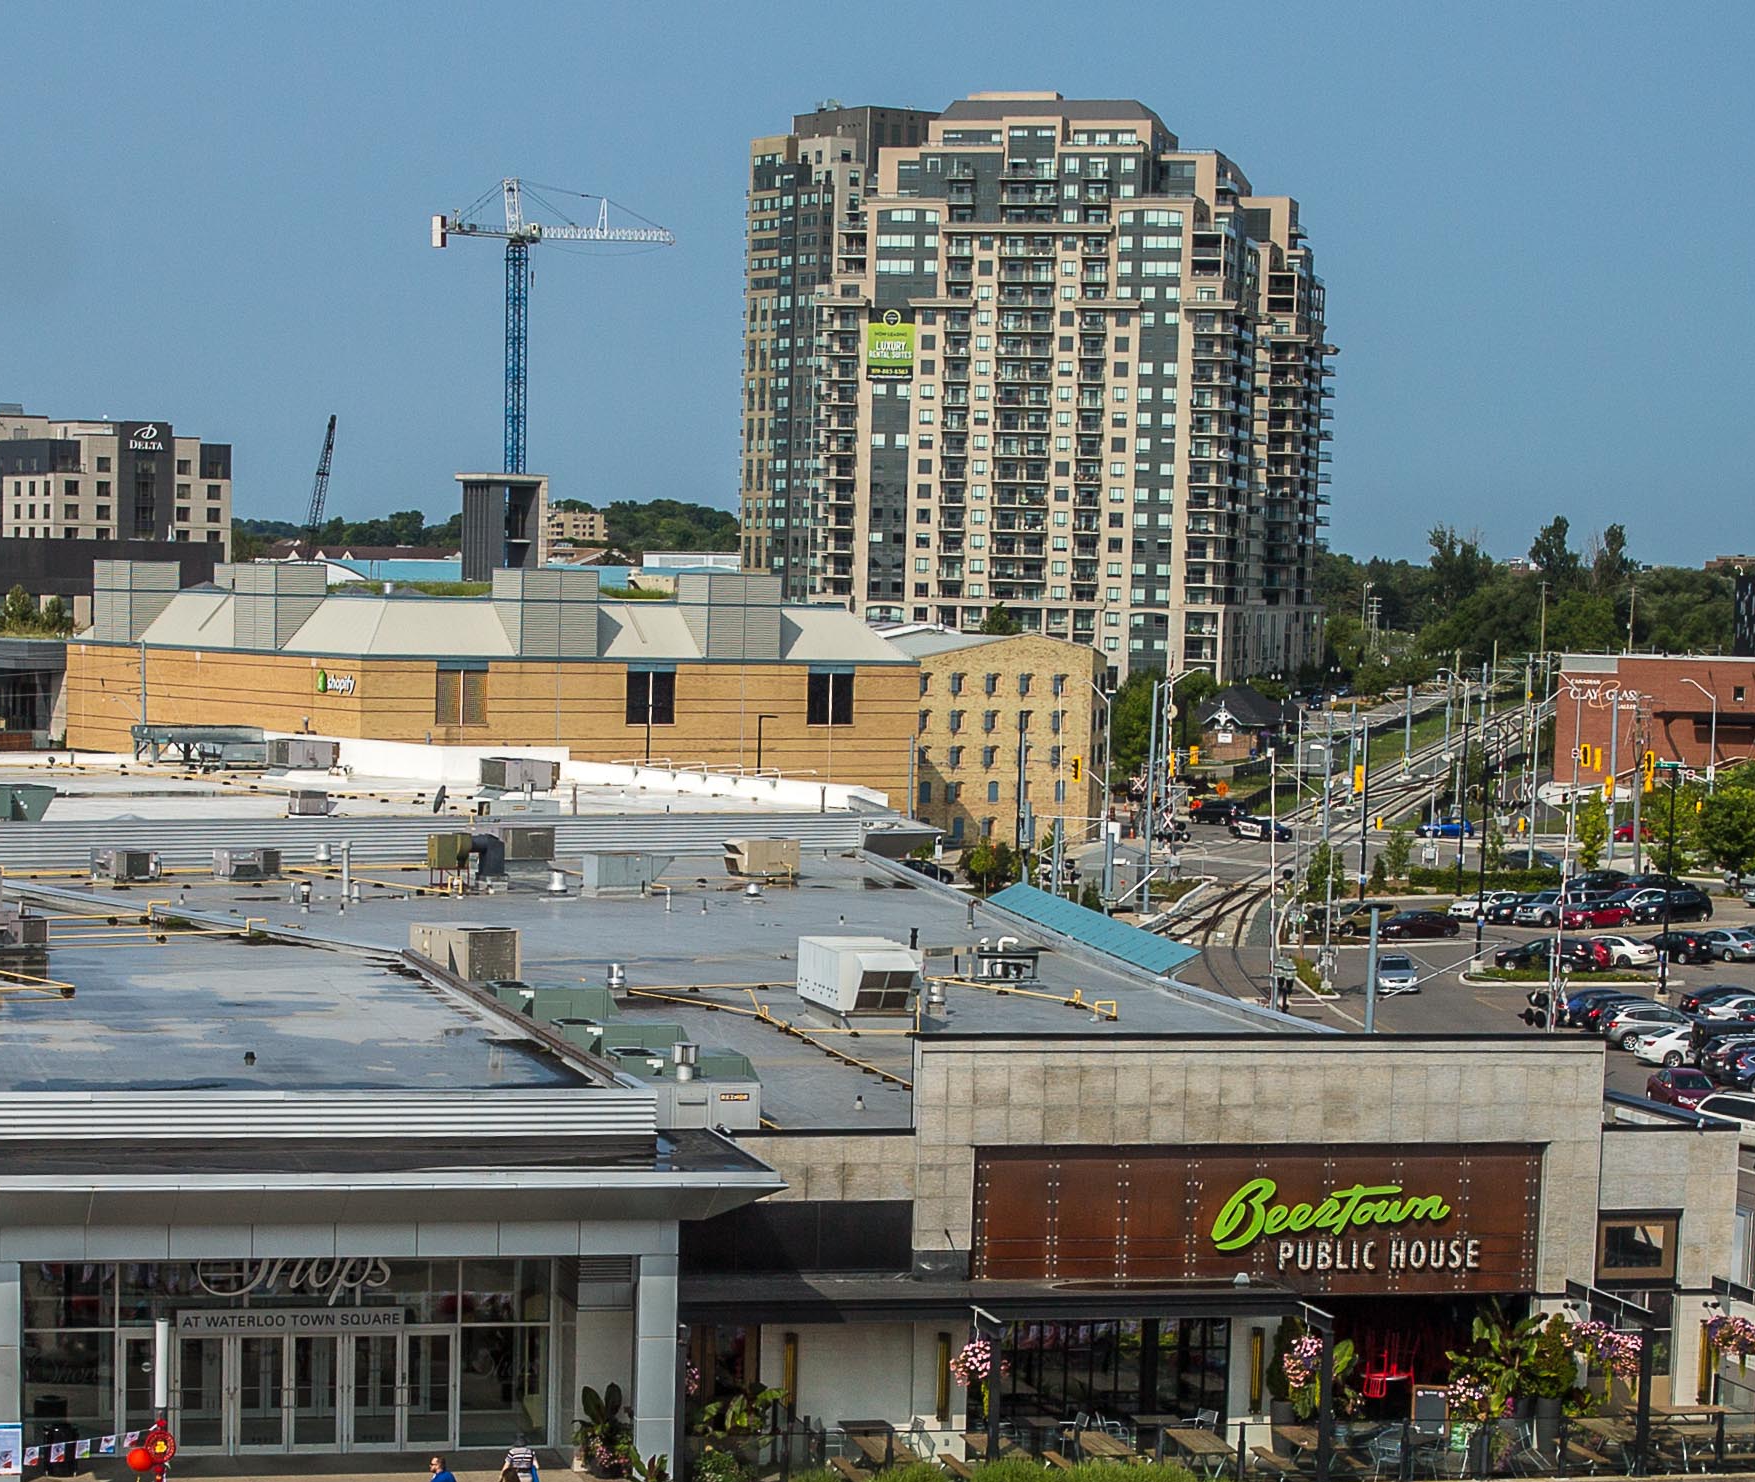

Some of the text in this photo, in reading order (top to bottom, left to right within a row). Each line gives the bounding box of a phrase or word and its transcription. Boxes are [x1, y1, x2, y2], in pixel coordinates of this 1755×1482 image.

[876, 340, 907, 350] LUXURY
[129, 439, 163, 450] DELTA
[327, 674, 355, 695] shopify
[1210, 1178, 1450, 1251] Beertown
[1278, 1238, 1483, 1271] PUBLIC HOUSE
[182, 1313, 401, 1328] AT WATERLOO TOWN SQUARE
